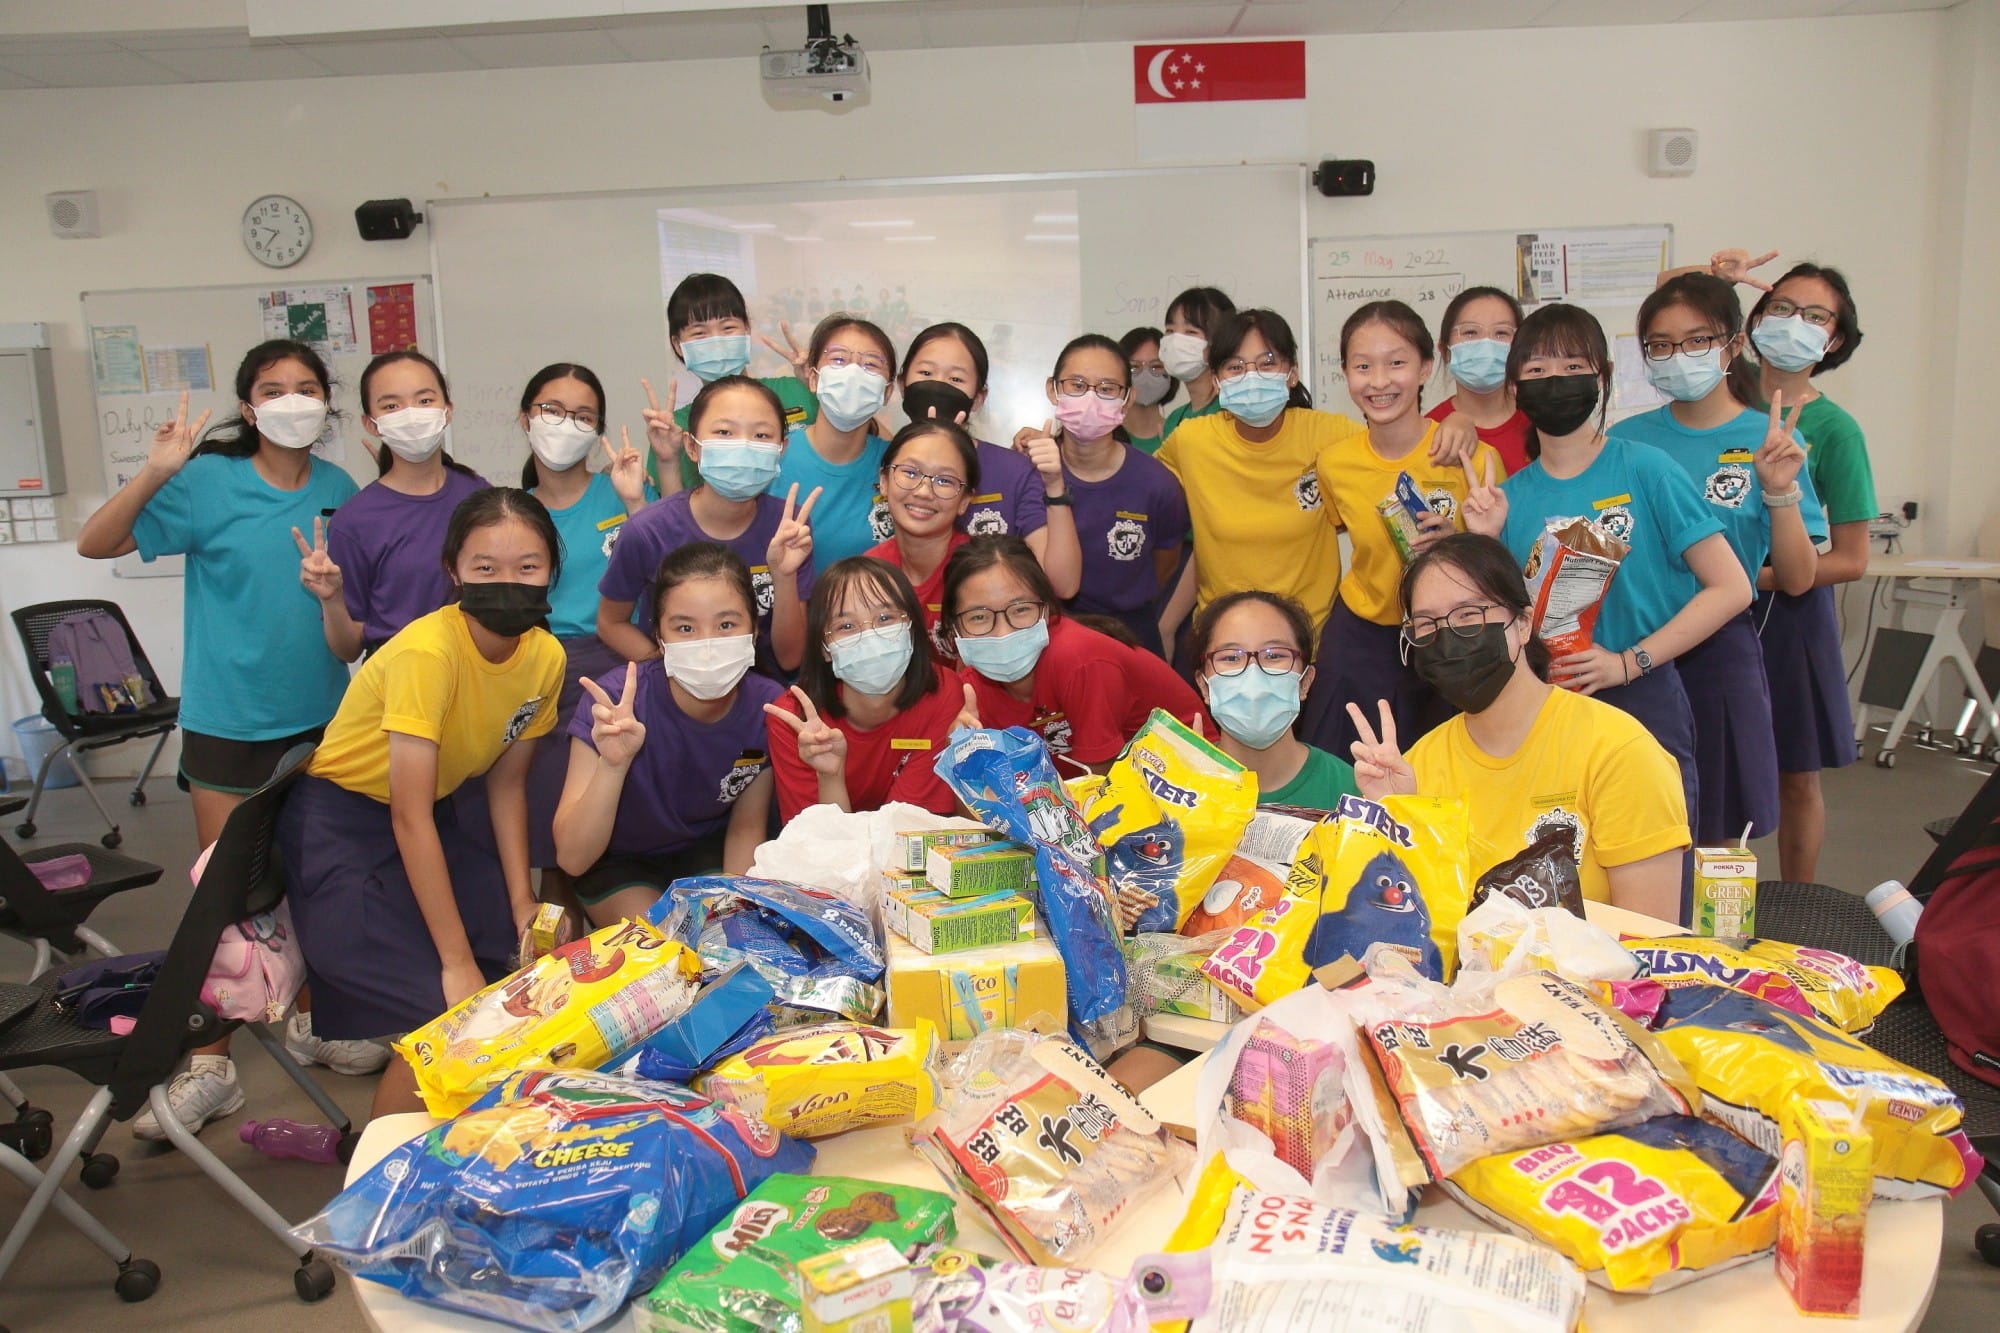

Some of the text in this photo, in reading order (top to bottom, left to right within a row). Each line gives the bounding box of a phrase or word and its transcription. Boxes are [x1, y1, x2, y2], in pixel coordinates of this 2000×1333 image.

[260, 208, 267, 216] 11
[271, 203, 279, 212] 12
[285, 206, 290, 215] 1
[252, 216, 262, 225] 10
[294, 214, 300, 223] 2
[251, 229, 257, 238] 9
[299, 226, 304, 236] 3
[255, 241, 262, 250] 8
[265, 249, 271, 258] 7
[277, 252, 284, 261] 6
[288, 248, 295, 257] 5
[1329, 250, 1450, 270] 25 May 2022
[1419, 291, 1436, 301] 28
[103, 409, 141, 443] Duty
[110, 450, 149, 467] Sweepin
[1705, 884, 1751, 899] GREEN
[1716, 900, 1740, 916] TEA
[1061, 1046, 1106, 1079] WANT
[534, 1140, 635, 1168] CHEESE
[1513, 1143, 1575, 1174] BBQ
[1537, 1154, 1583, 1181] FLAVOUR
[1544, 1160, 1666, 1226] 12
[1602, 1198, 1691, 1249] PACKS
